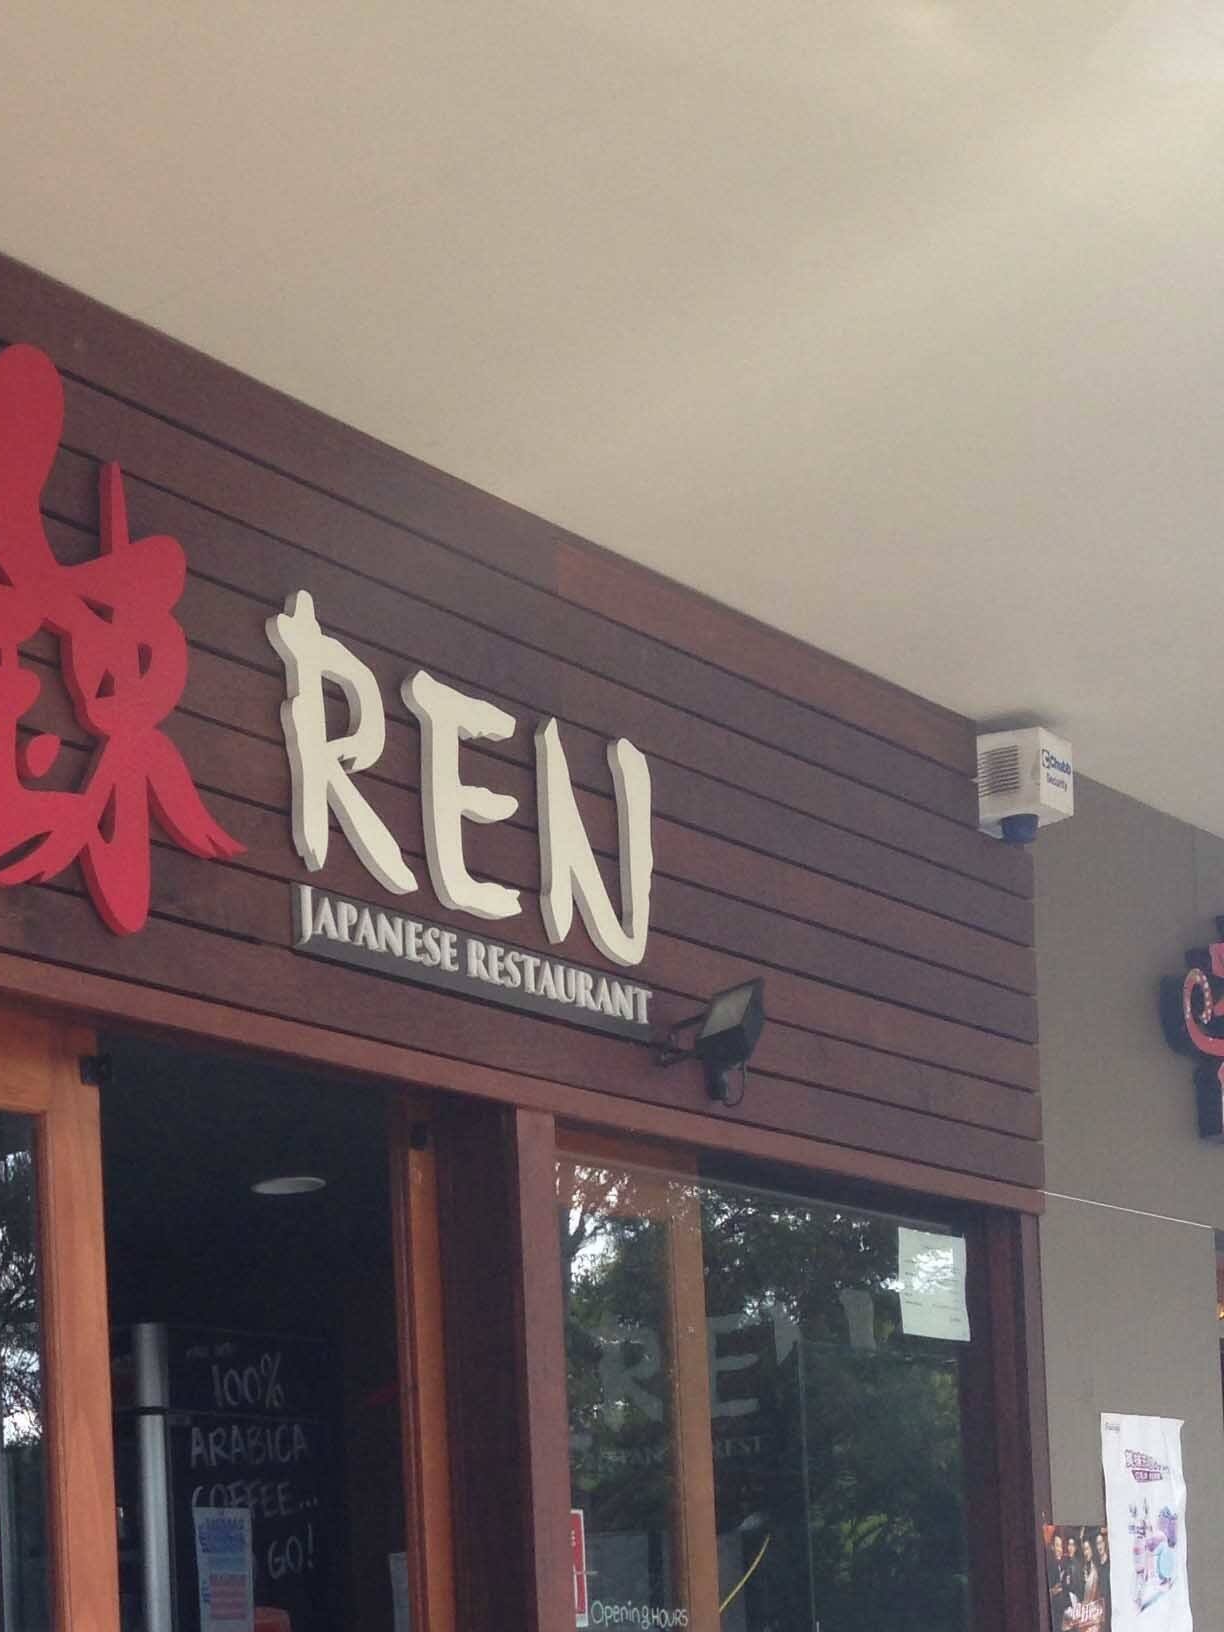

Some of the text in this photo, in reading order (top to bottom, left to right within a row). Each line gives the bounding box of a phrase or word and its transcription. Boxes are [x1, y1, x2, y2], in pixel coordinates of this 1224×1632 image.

[266, 589, 654, 965] REN
[295, 884, 653, 1025] JAPANESE RESTAURANT
[210, 1351, 286, 1409] 100%
[189, 1423, 309, 1470] ARABICA
[267, 1522, 314, 1580] GO!
[590, 1599, 689, 1630] Opening HOURS
